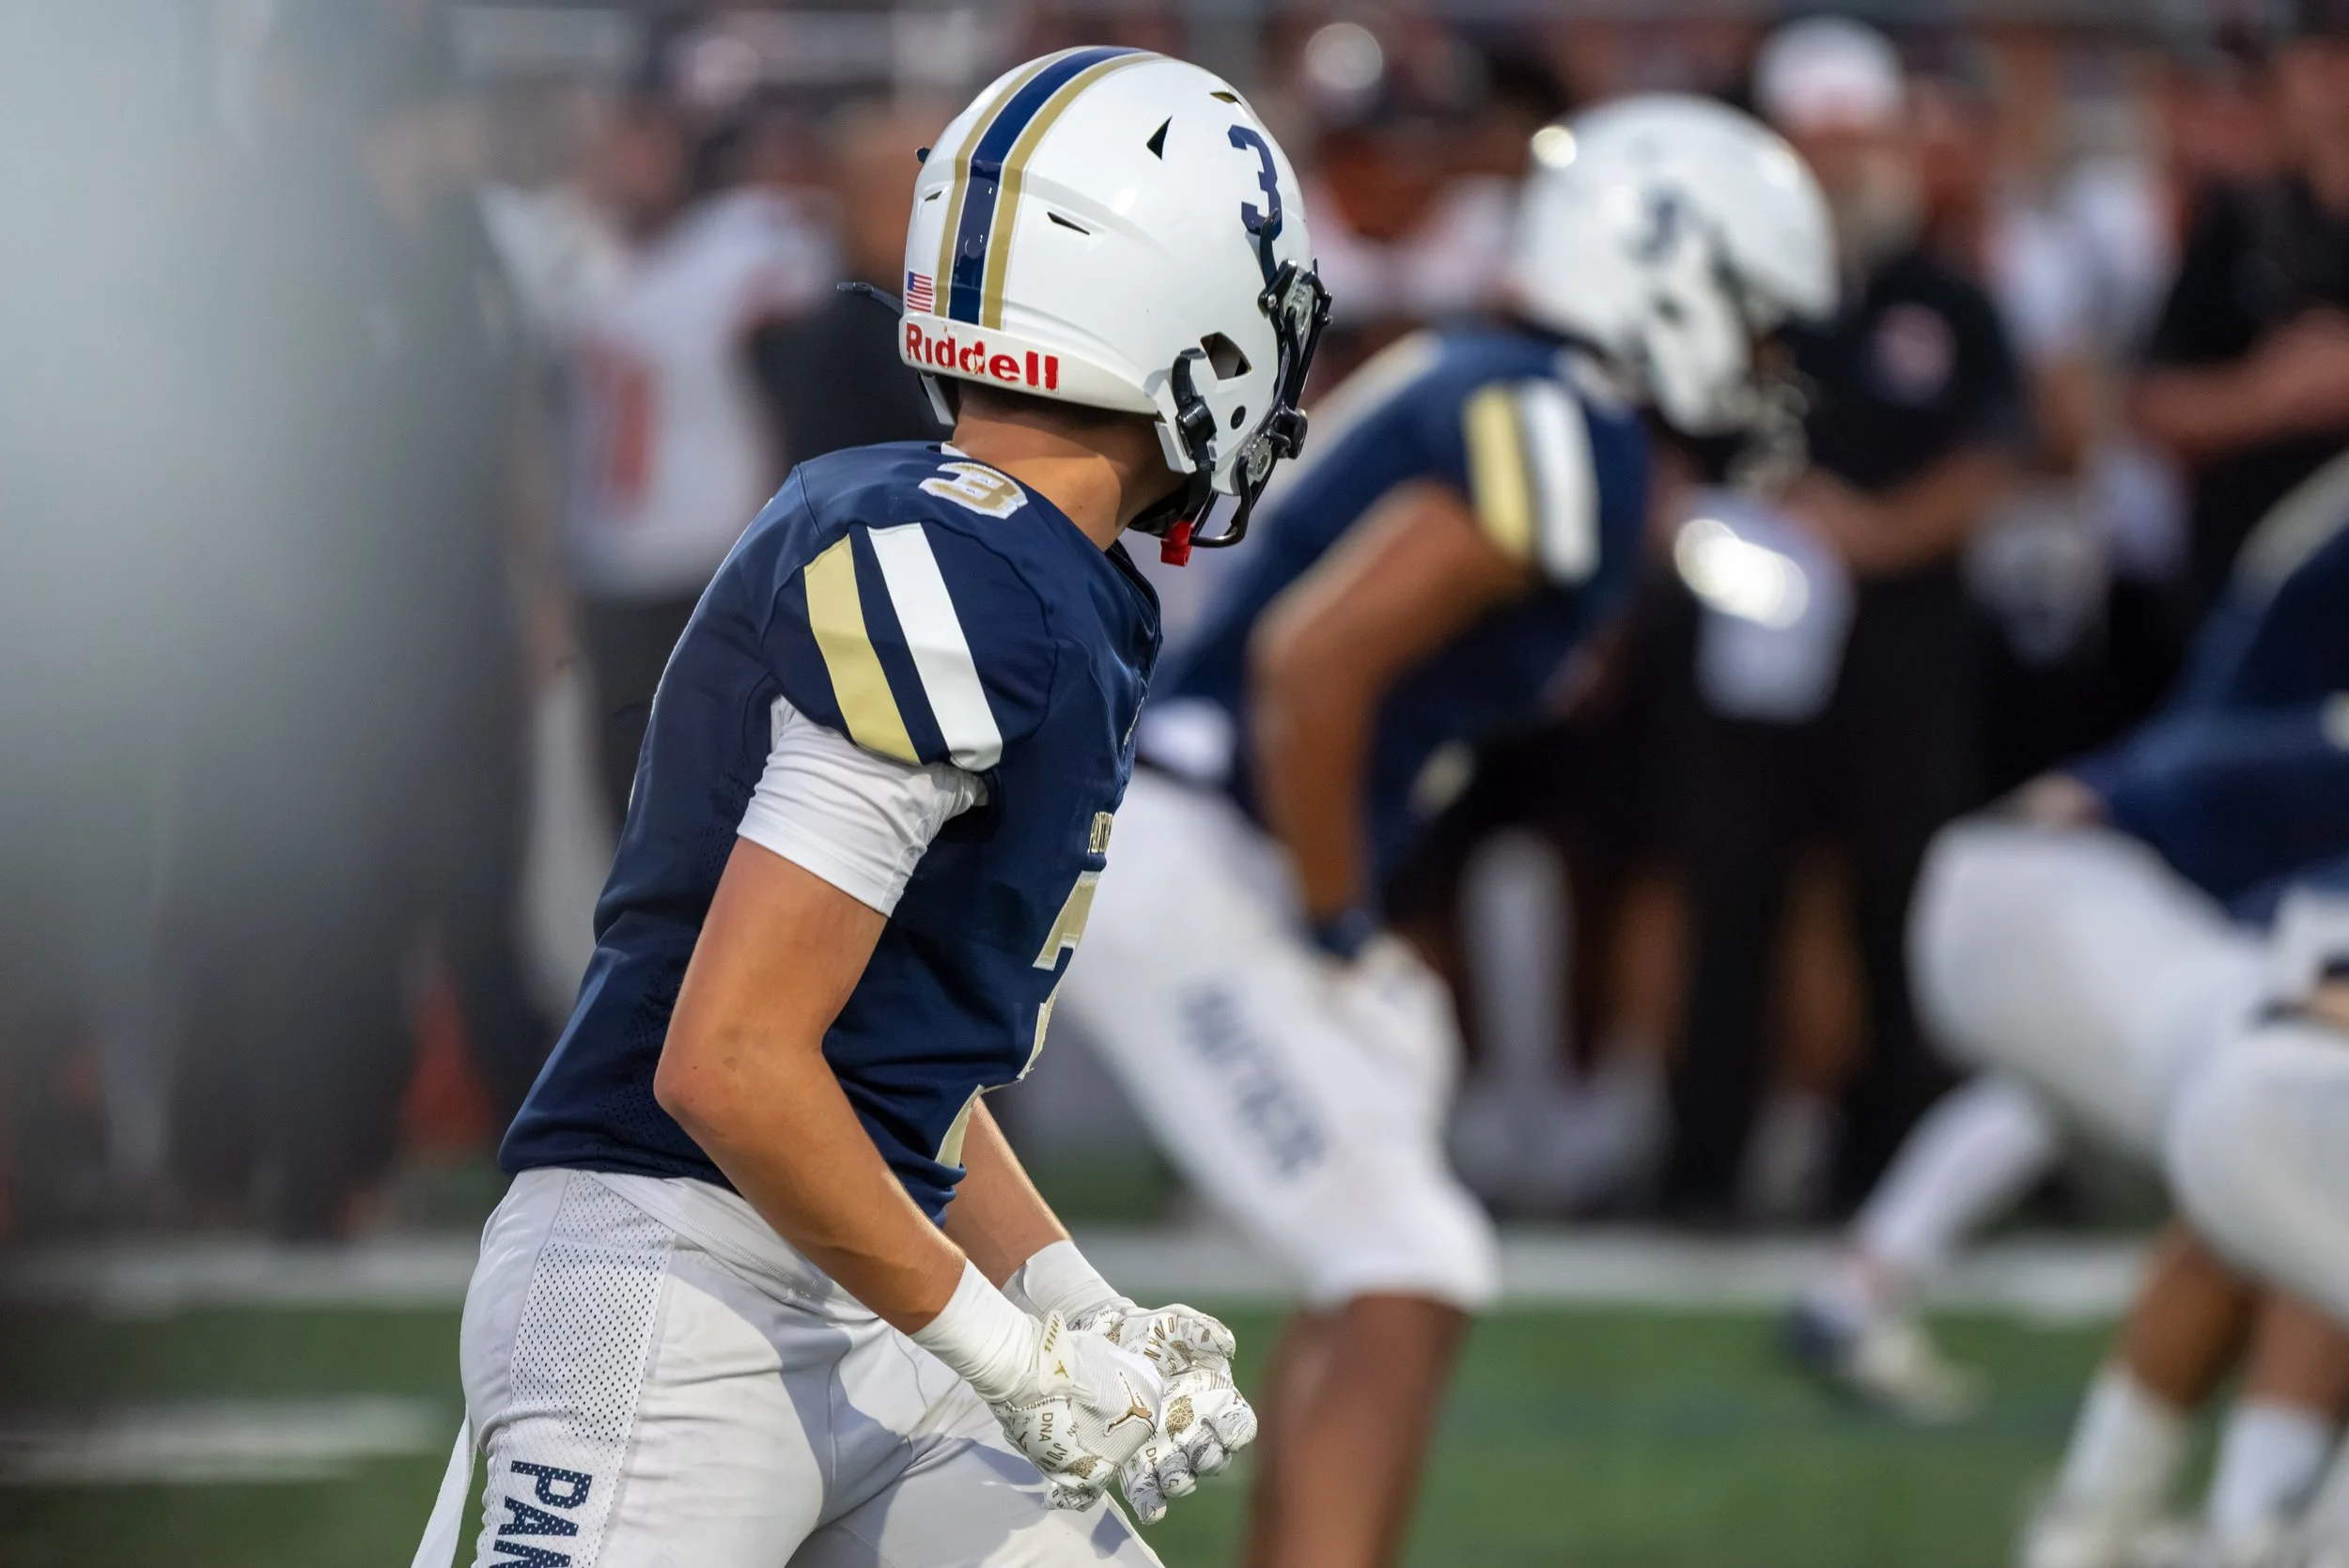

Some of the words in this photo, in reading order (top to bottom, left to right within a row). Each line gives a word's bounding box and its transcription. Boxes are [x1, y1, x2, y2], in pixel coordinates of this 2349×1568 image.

[1227, 124, 1283, 241] 3
[907, 322, 1059, 391] Riddell
[918, 461, 1029, 520] 3
[1038, 1412, 1053, 1442] DNA
